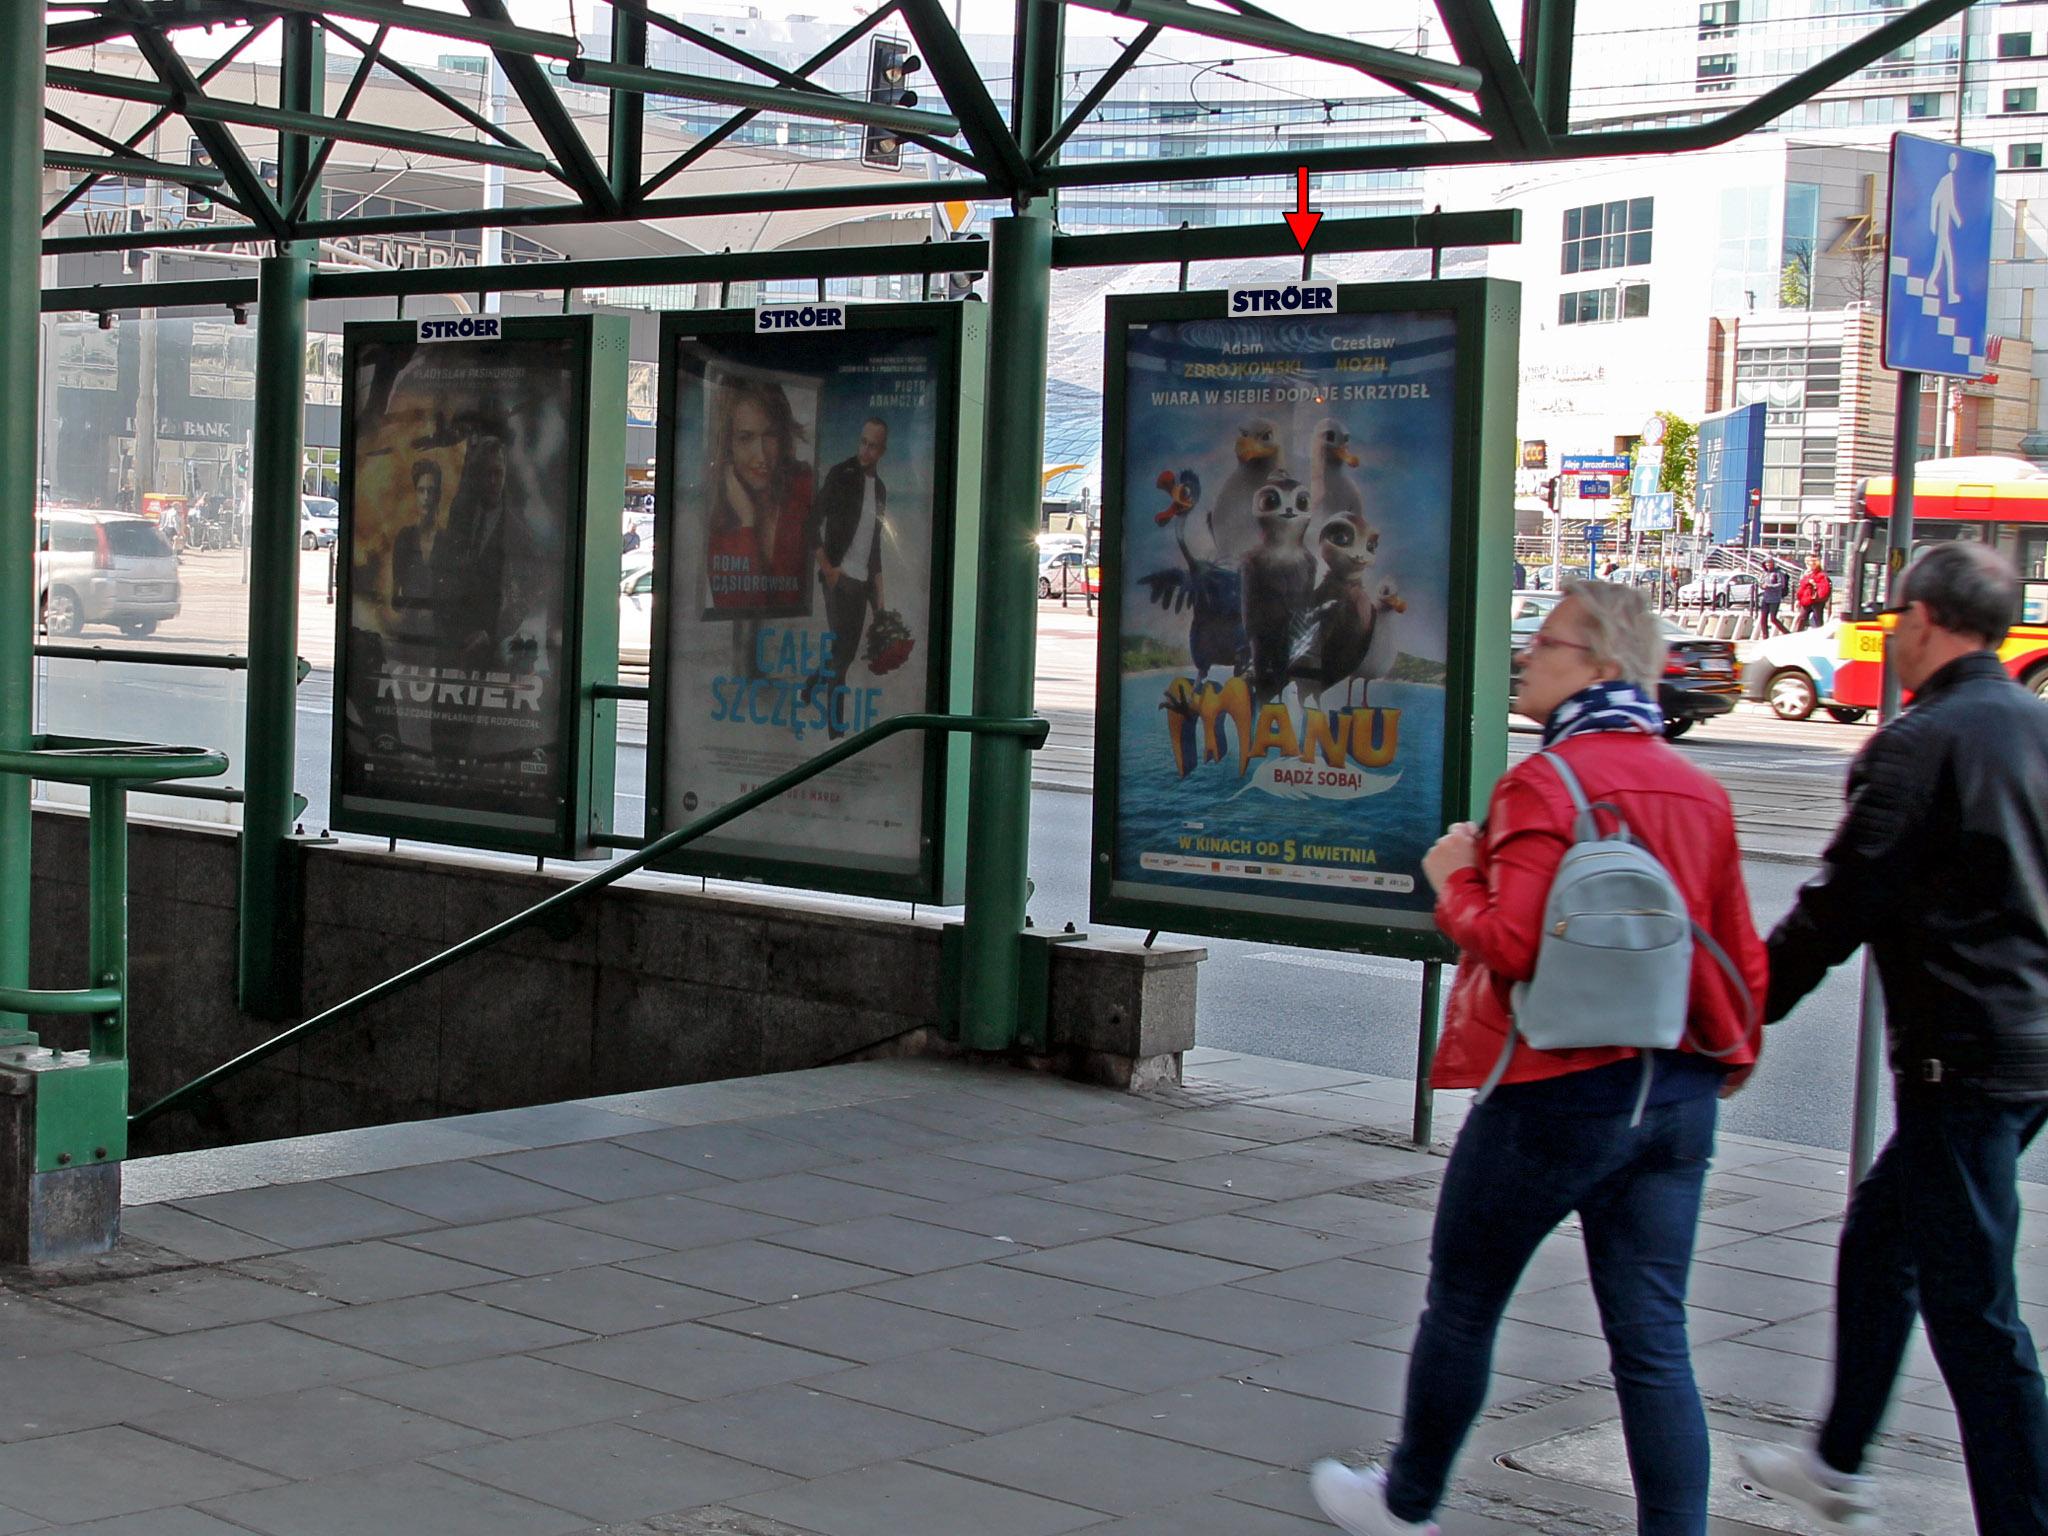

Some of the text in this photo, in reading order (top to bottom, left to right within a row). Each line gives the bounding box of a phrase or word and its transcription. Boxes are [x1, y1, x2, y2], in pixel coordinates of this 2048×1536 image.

[1232, 285, 1333, 313] STRÖER
[420, 317, 499, 339] STRÖER
[759, 306, 842, 329] STRÖER
[1222, 341, 1263, 355] Adam
[1331, 335, 1396, 352] Czesław
[1184, 360, 1304, 378] ZDRÓJKOWSKI
[1336, 357, 1390, 373] MOZIL
[1151, 383, 1431, 406] WIARA W SIEBIE DODAJE SKRZYDEŁ
[183, 421, 231, 437] BANK
[713, 554, 750, 572] ROMA
[756, 628, 839, 679] CAŁE
[377, 662, 544, 711] KURIER
[1166, 677, 1402, 779] MANU
[1317, 771, 1362, 791] SOBĄ!
[1179, 836, 1377, 864] W KINACH OD 5 KWIETNIA
